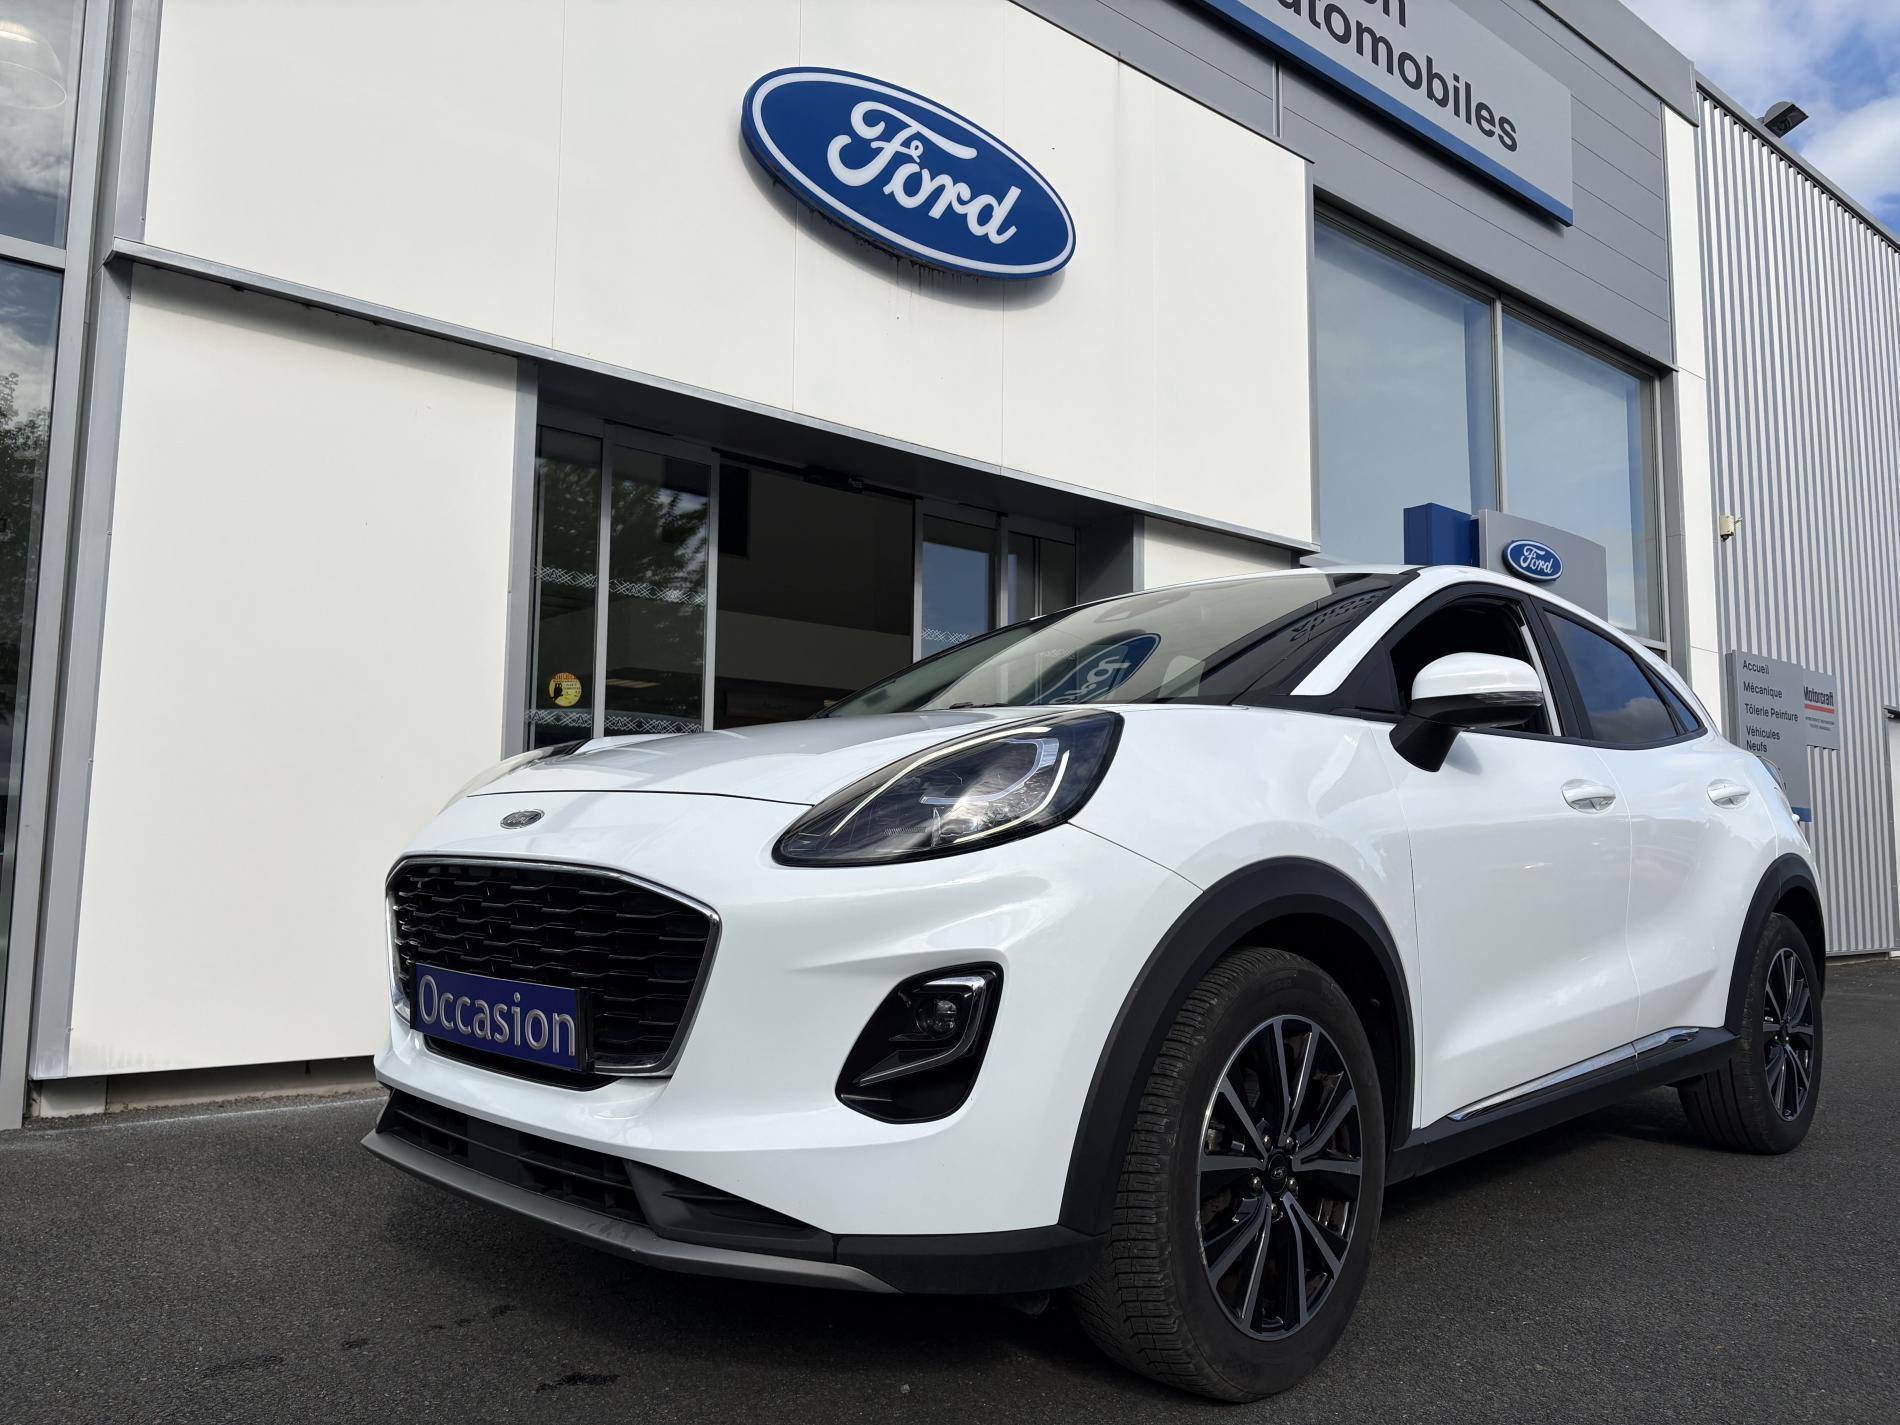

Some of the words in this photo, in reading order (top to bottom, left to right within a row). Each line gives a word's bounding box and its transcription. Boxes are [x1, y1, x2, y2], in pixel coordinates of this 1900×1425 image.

[827, 101, 1022, 244] Ford
[1520, 545, 1554, 574] Ford
[1743, 660, 1769, 675] Accueil
[1743, 681, 1783, 699] Mécanique
[1744, 703, 1769, 717] Tôlerie
[1770, 707, 1798, 722] Peinture
[1746, 725, 1780, 740] Véhicules
[1746, 739, 1768, 752] Neufs
[418, 974, 576, 1057] Occasion
